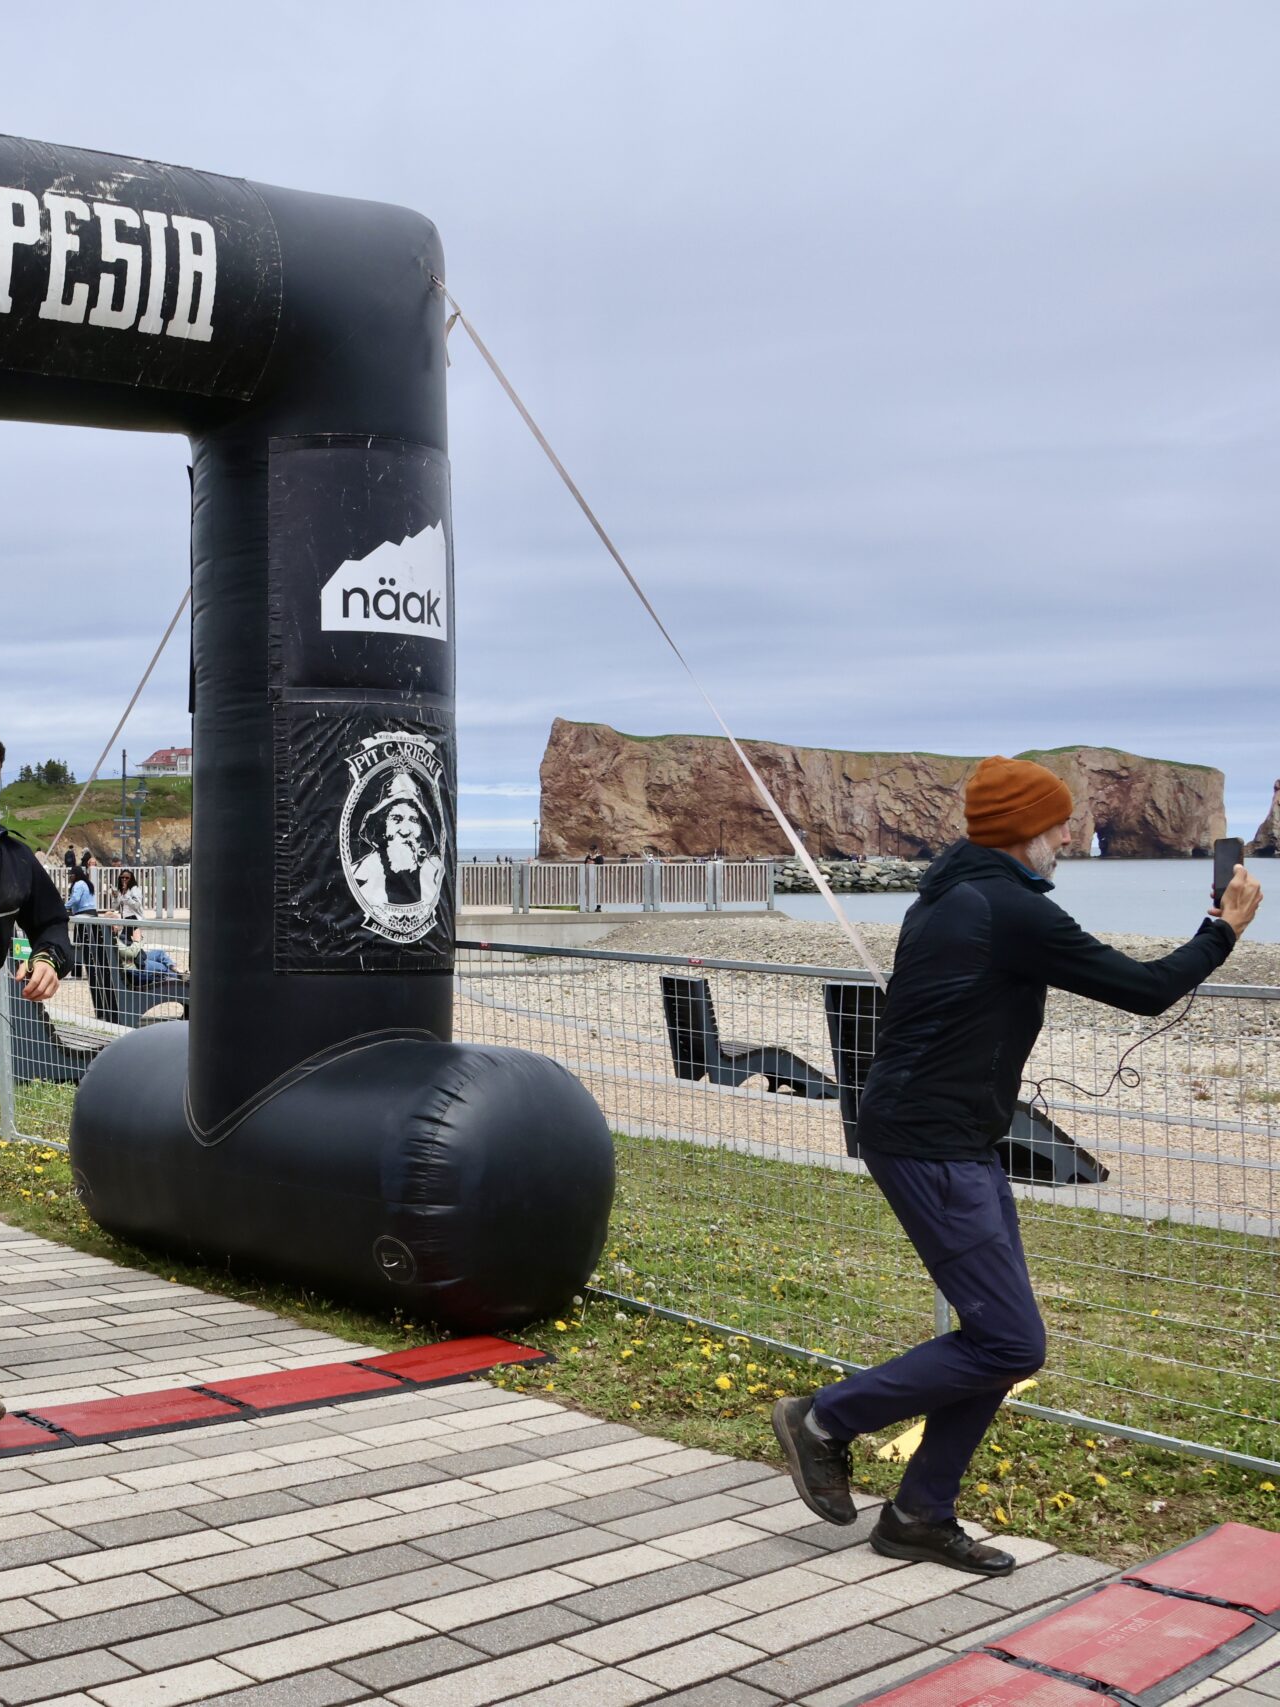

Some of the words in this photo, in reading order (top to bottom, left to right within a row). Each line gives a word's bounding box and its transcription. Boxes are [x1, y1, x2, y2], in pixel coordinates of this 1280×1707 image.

[342, 576, 442, 628] näak
[354, 748, 379, 772] PIT
[383, 742, 439, 775] CARIBOU
